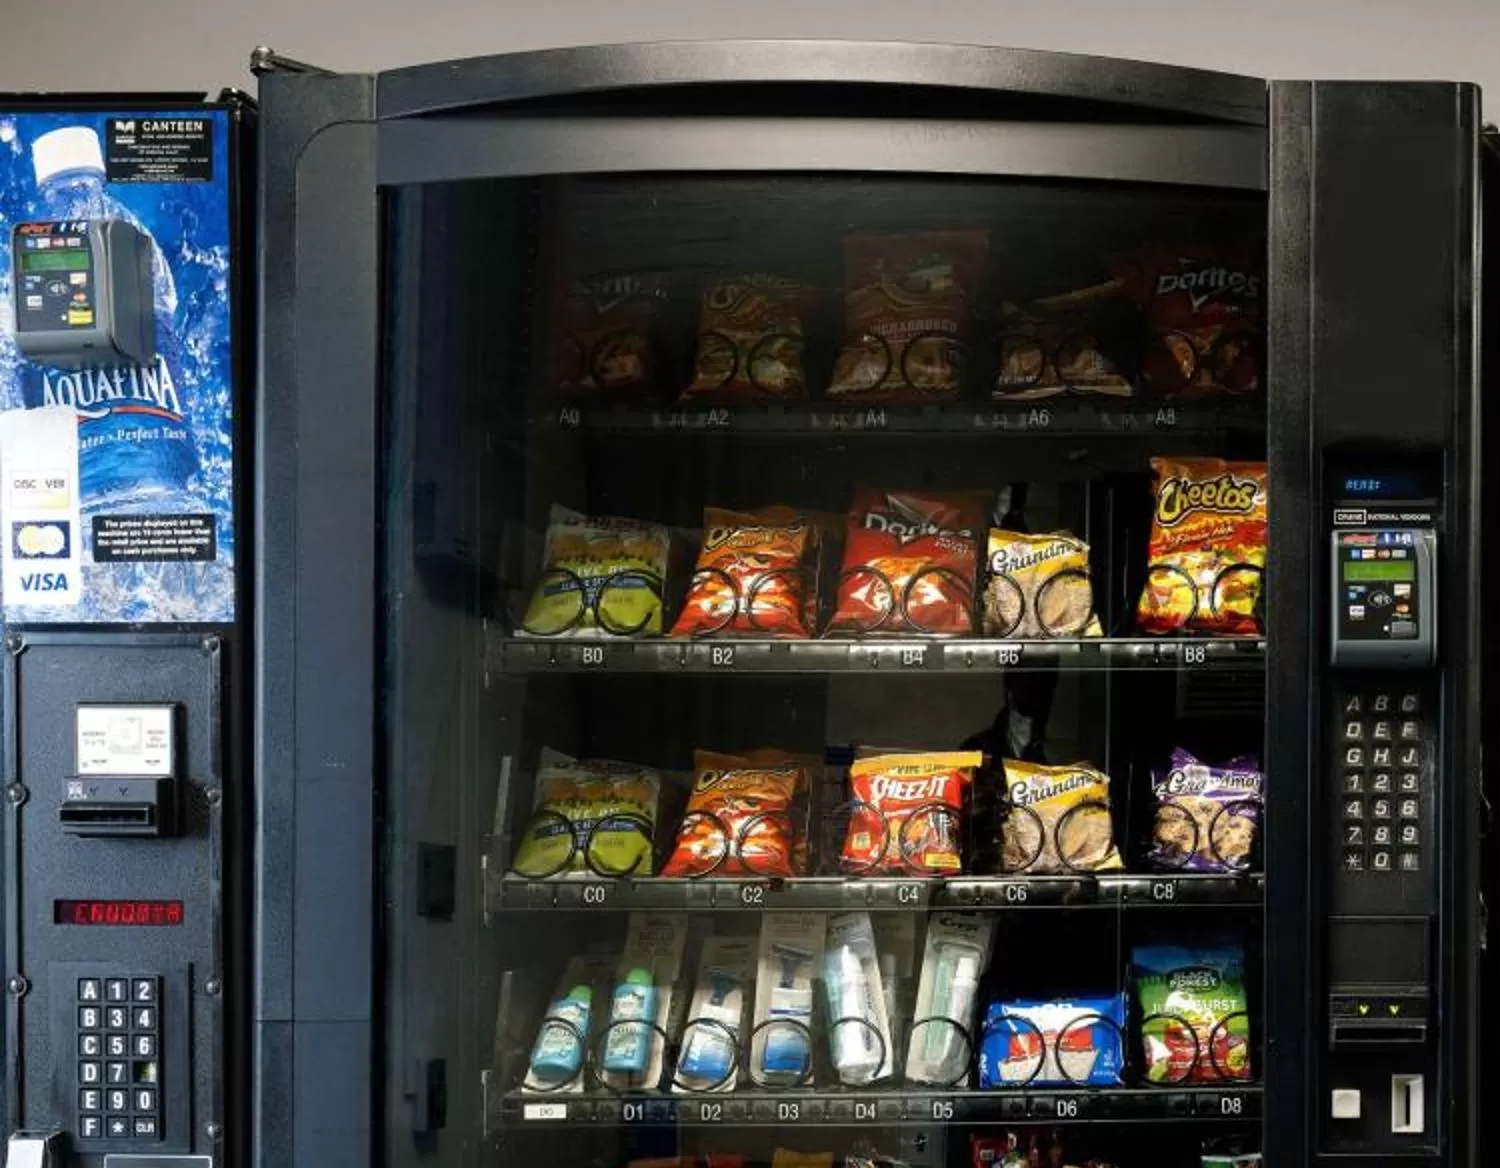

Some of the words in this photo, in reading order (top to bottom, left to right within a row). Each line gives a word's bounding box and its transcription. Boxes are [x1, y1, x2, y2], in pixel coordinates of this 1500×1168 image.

[142, 121, 203, 131] CANTEEN
[1155, 265, 1262, 296] Doritos
[707, 409, 729, 426] A2
[1028, 410, 1050, 425] A6
[1155, 410, 1176, 425] A8
[117, 428, 159, 442] Perfect
[1157, 475, 1257, 525] Cheetos
[20, 573, 68, 591] VISA
[583, 649, 603, 664] B0
[712, 649, 733, 665] B2
[903, 650, 923, 664] B4
[1000, 649, 1018, 664] B6
[1185, 647, 1205, 662] B8
[1346, 696, 1361, 711] A
[1374, 696, 1389, 711] B
[1402, 696, 1416, 711] C
[1346, 722, 1361, 737] D
[1374, 722, 1389, 737] E
[1402, 722, 1416, 737] F
[1346, 748, 1361, 763] G
[1374, 748, 1389, 763] H
[1402, 748, 1416, 763] J
[1346, 774, 1361, 789] 1
[1374, 774, 1389, 789] 2
[1402, 774, 1416, 789] 3
[1346, 801, 1361, 816] 4
[1374, 801, 1389, 816] 5
[1402, 801, 1416, 816] 6
[1346, 827, 1361, 841] 7
[1374, 827, 1389, 841] 8
[1402, 827, 1416, 841] 9
[584, 887, 605, 903] C0
[741, 887, 762, 903] C2
[899, 886, 919, 901] C4
[1006, 886, 1027, 901] C6
[1154, 883, 1173, 899] C8
[84, 982, 96, 999] A
[112, 982, 120, 999] 1
[139, 982, 149, 1000] 2
[1169, 978, 1218, 988] FOREST
[84, 1009, 95, 1026] B
[112, 1010, 122, 1026] 3
[139, 1010, 149, 1026] 4
[84, 1037, 95, 1054] C
[112, 1037, 122, 1054] 5
[140, 1037, 149, 1054] 6
[85, 1064, 96, 1081] D
[112, 1064, 122, 1081] 7
[86, 1092, 95, 1108] E
[113, 1092, 123, 1109] 9
[140, 1092, 150, 1109] 0
[623, 1104, 643, 1119] D1
[701, 1104, 721, 1119] D2
[779, 1104, 799, 1119] D3
[856, 1103, 876, 1119] D4
[933, 1102, 953, 1118] D5
[1057, 1101, 1077, 1116] D6
[1221, 1098, 1242, 1114] D8
[86, 1119, 95, 1136] F
